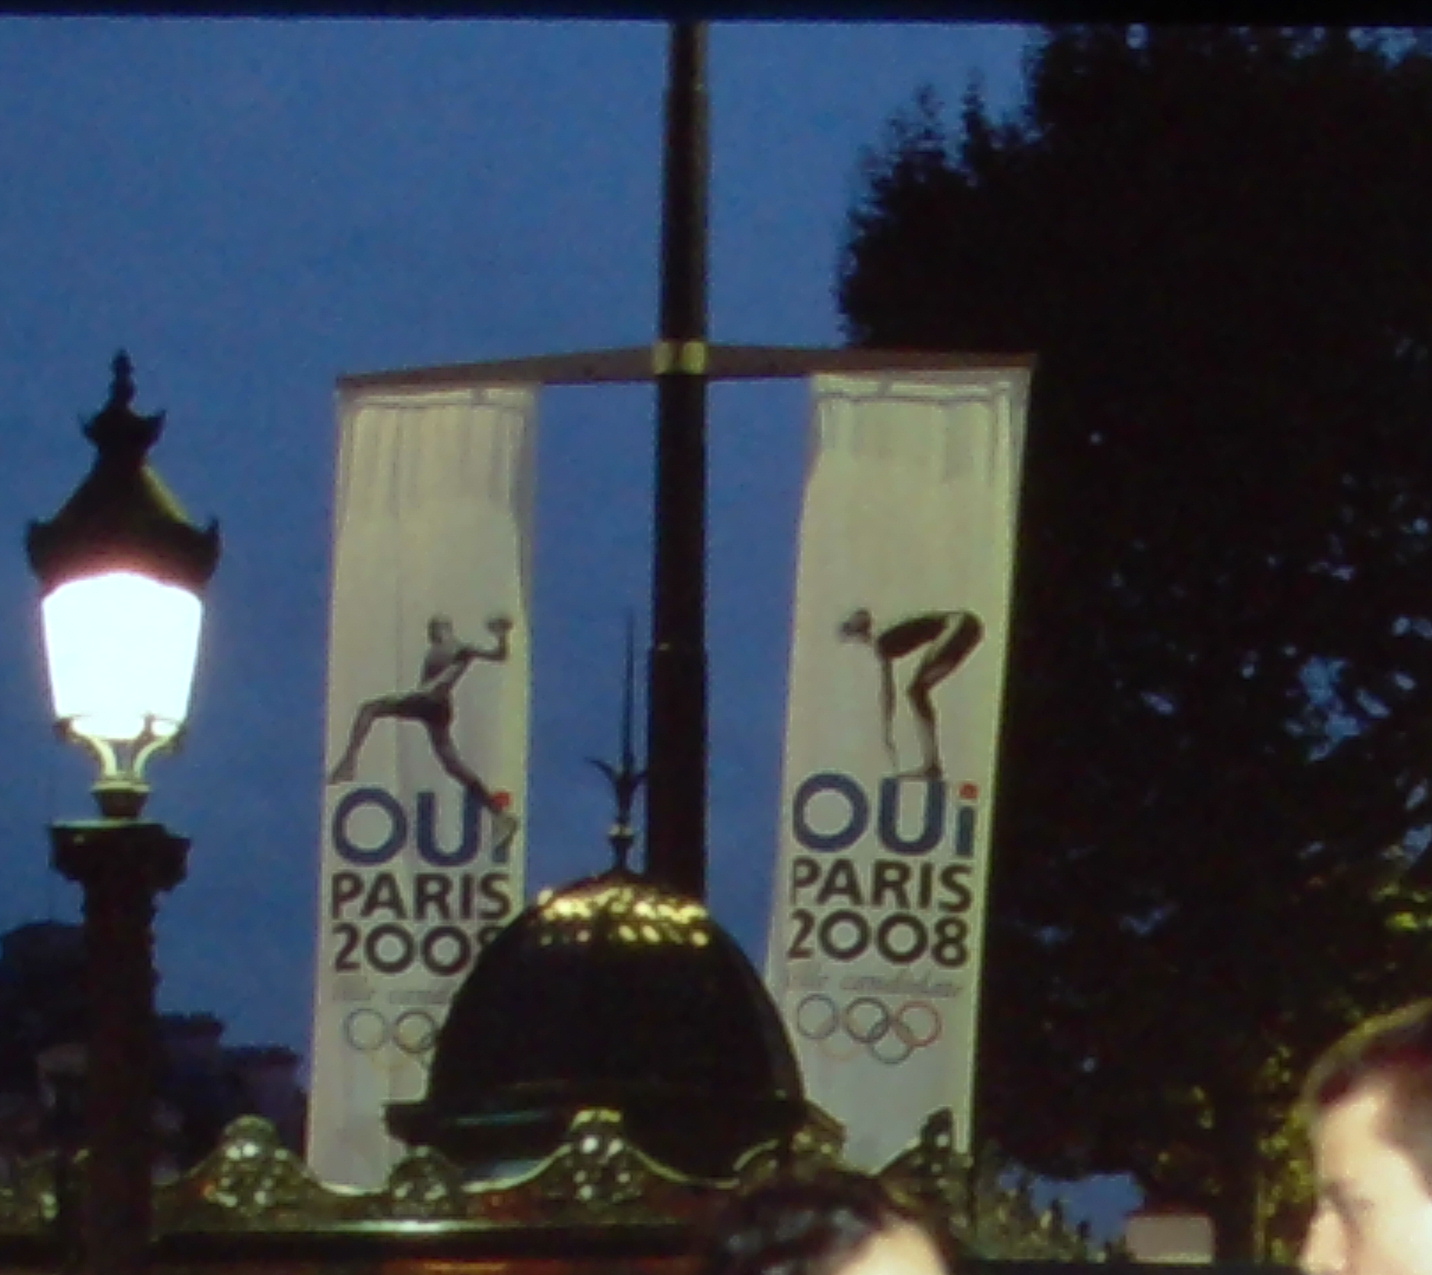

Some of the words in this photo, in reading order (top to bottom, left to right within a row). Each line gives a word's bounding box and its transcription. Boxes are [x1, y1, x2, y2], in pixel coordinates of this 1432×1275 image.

[332, 872, 512, 920] PARIS
[792, 857, 973, 912] PARIS
[787, 908, 969, 968] 2008
